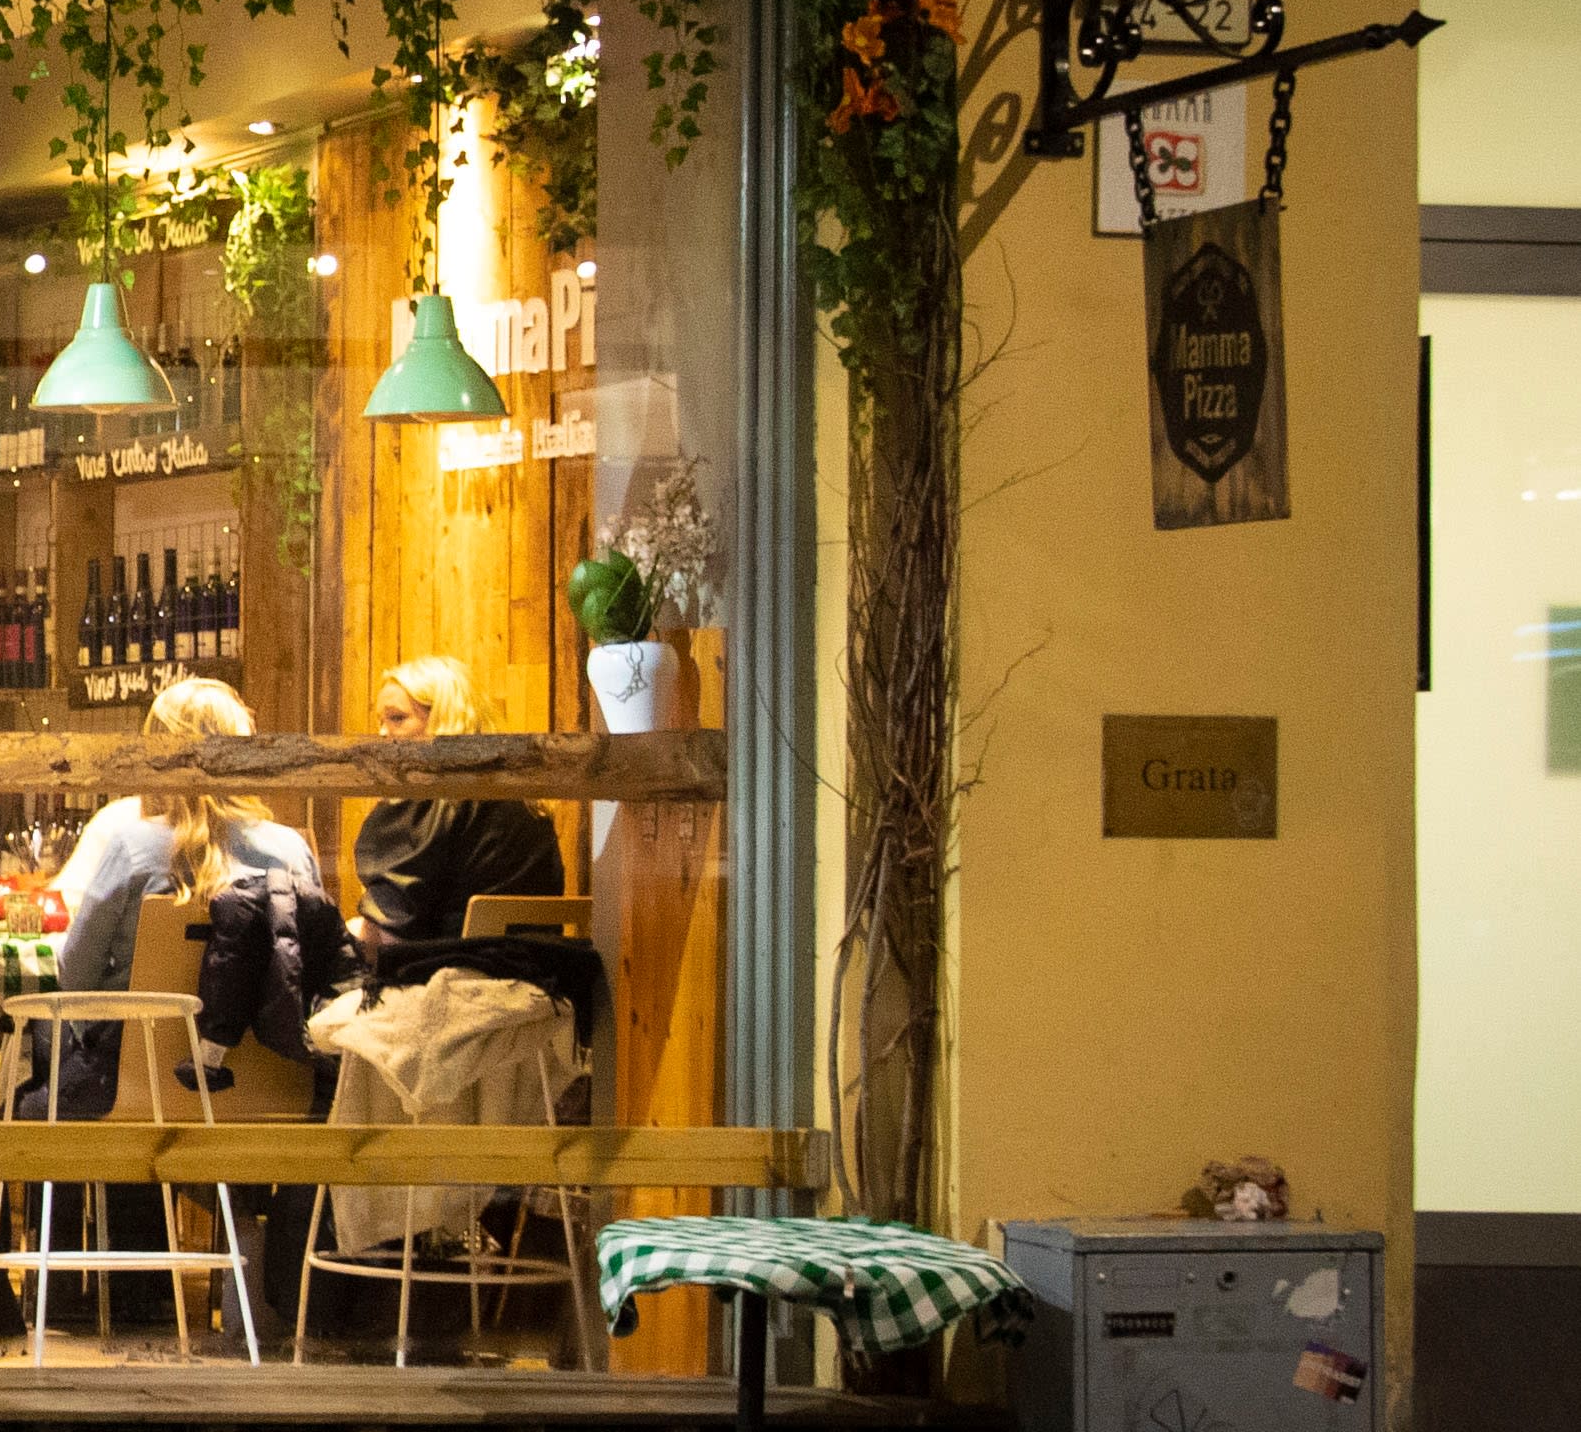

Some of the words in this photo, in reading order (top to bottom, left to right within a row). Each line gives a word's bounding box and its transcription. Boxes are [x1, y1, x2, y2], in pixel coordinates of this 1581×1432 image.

[1170, 321, 1253, 369] Mamma
[1183, 373, 1239, 419] Pizza
[75, 452, 108, 481] Vino
[160, 434, 209, 476] Italia
[83, 670, 117, 702] Vino
